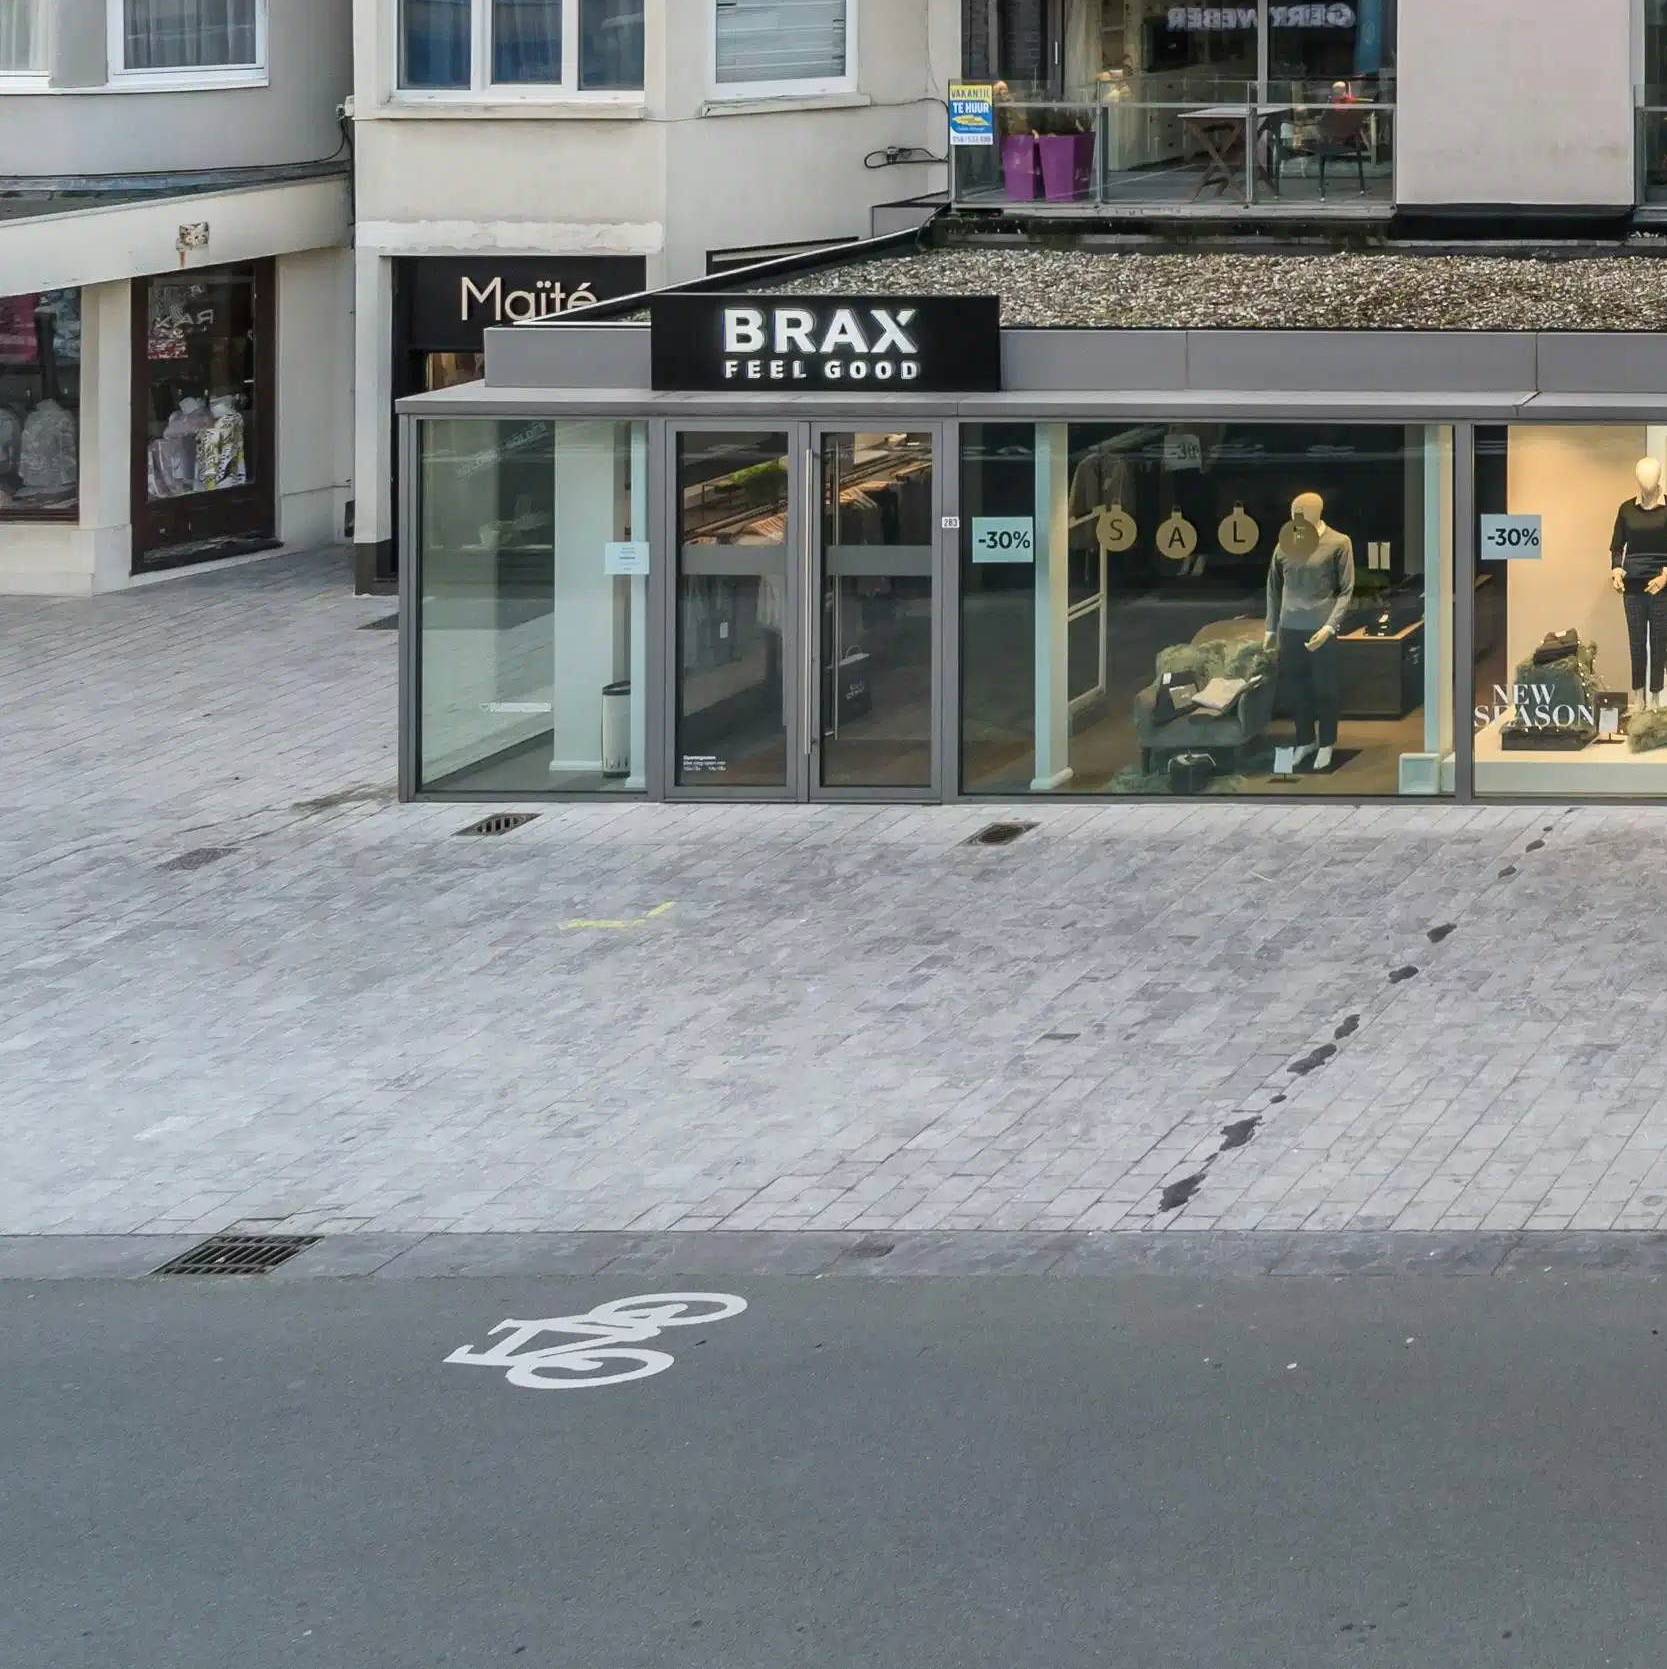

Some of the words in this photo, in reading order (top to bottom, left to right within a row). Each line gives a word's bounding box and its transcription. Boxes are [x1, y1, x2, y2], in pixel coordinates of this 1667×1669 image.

[952, 102, 964, 113] TE
[965, 102, 989, 113] HUUR
[461, 276, 598, 321] Maïté
[723, 308, 918, 353] BRAX
[724, 360, 807, 379] FEEL
[824, 360, 918, 380] GOOD
[943, 518, 958, 527] 283
[978, 531, 1031, 549] -30%
[1486, 528, 1540, 547] -30%
[1492, 684, 1556, 705] NEW
[1474, 705, 1595, 727] SEASON
